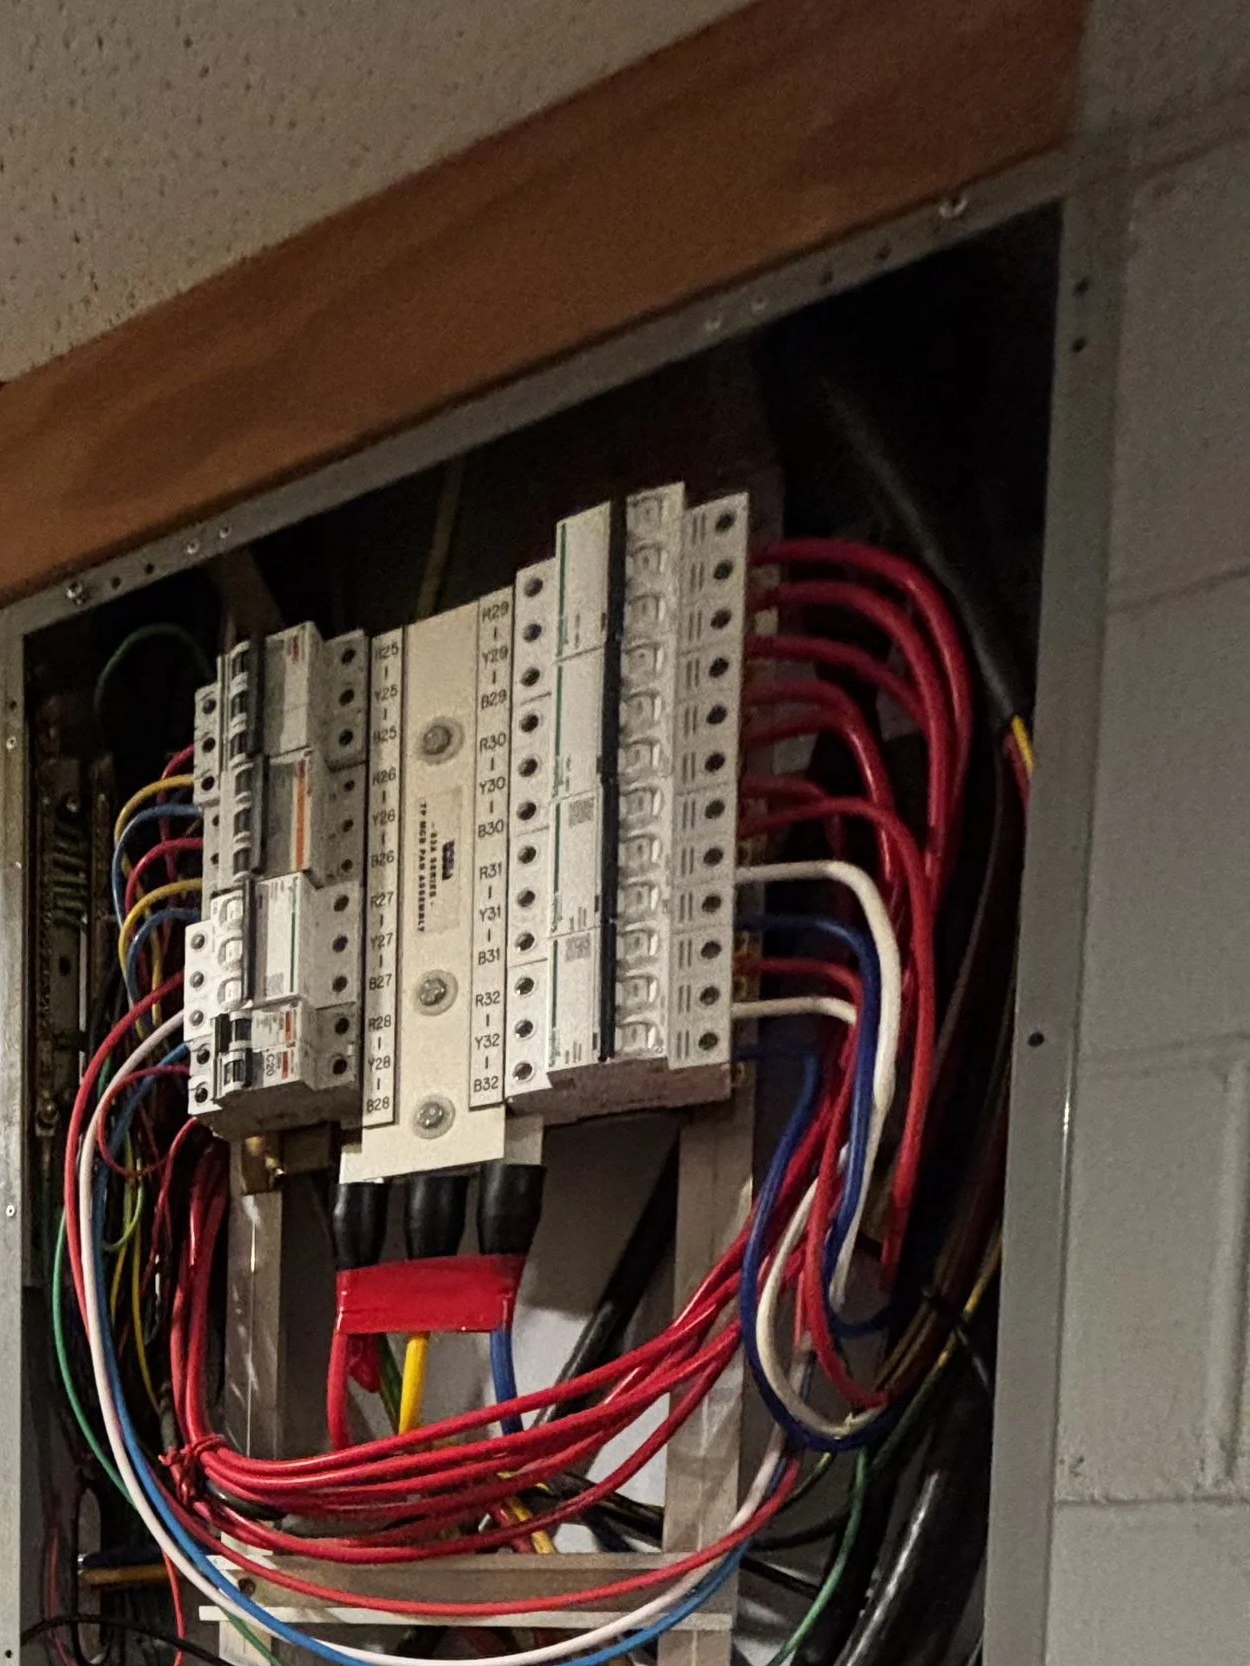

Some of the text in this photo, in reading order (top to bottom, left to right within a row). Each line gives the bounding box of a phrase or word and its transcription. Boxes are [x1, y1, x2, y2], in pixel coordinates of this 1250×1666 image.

[481, 689, 507, 710] B29
[479, 733, 506, 752] R30
[479, 776, 506, 795] Y30
[372, 809, 396, 827] Y26
[478, 819, 504, 838] B30
[479, 862, 502, 880] R31
[370, 891, 394, 907] R27
[479, 906, 501, 923] Y31
[370, 933, 393, 949] Y27
[478, 947, 500, 966] B31
[369, 973, 392, 991] B27
[475, 990, 501, 1007] R32
[368, 1014, 392, 1032] R28
[474, 1033, 500, 1050] Y32
[368, 1055, 391, 1073] Y28
[473, 1075, 499, 1094] B32
[366, 1095, 390, 1114] B28
